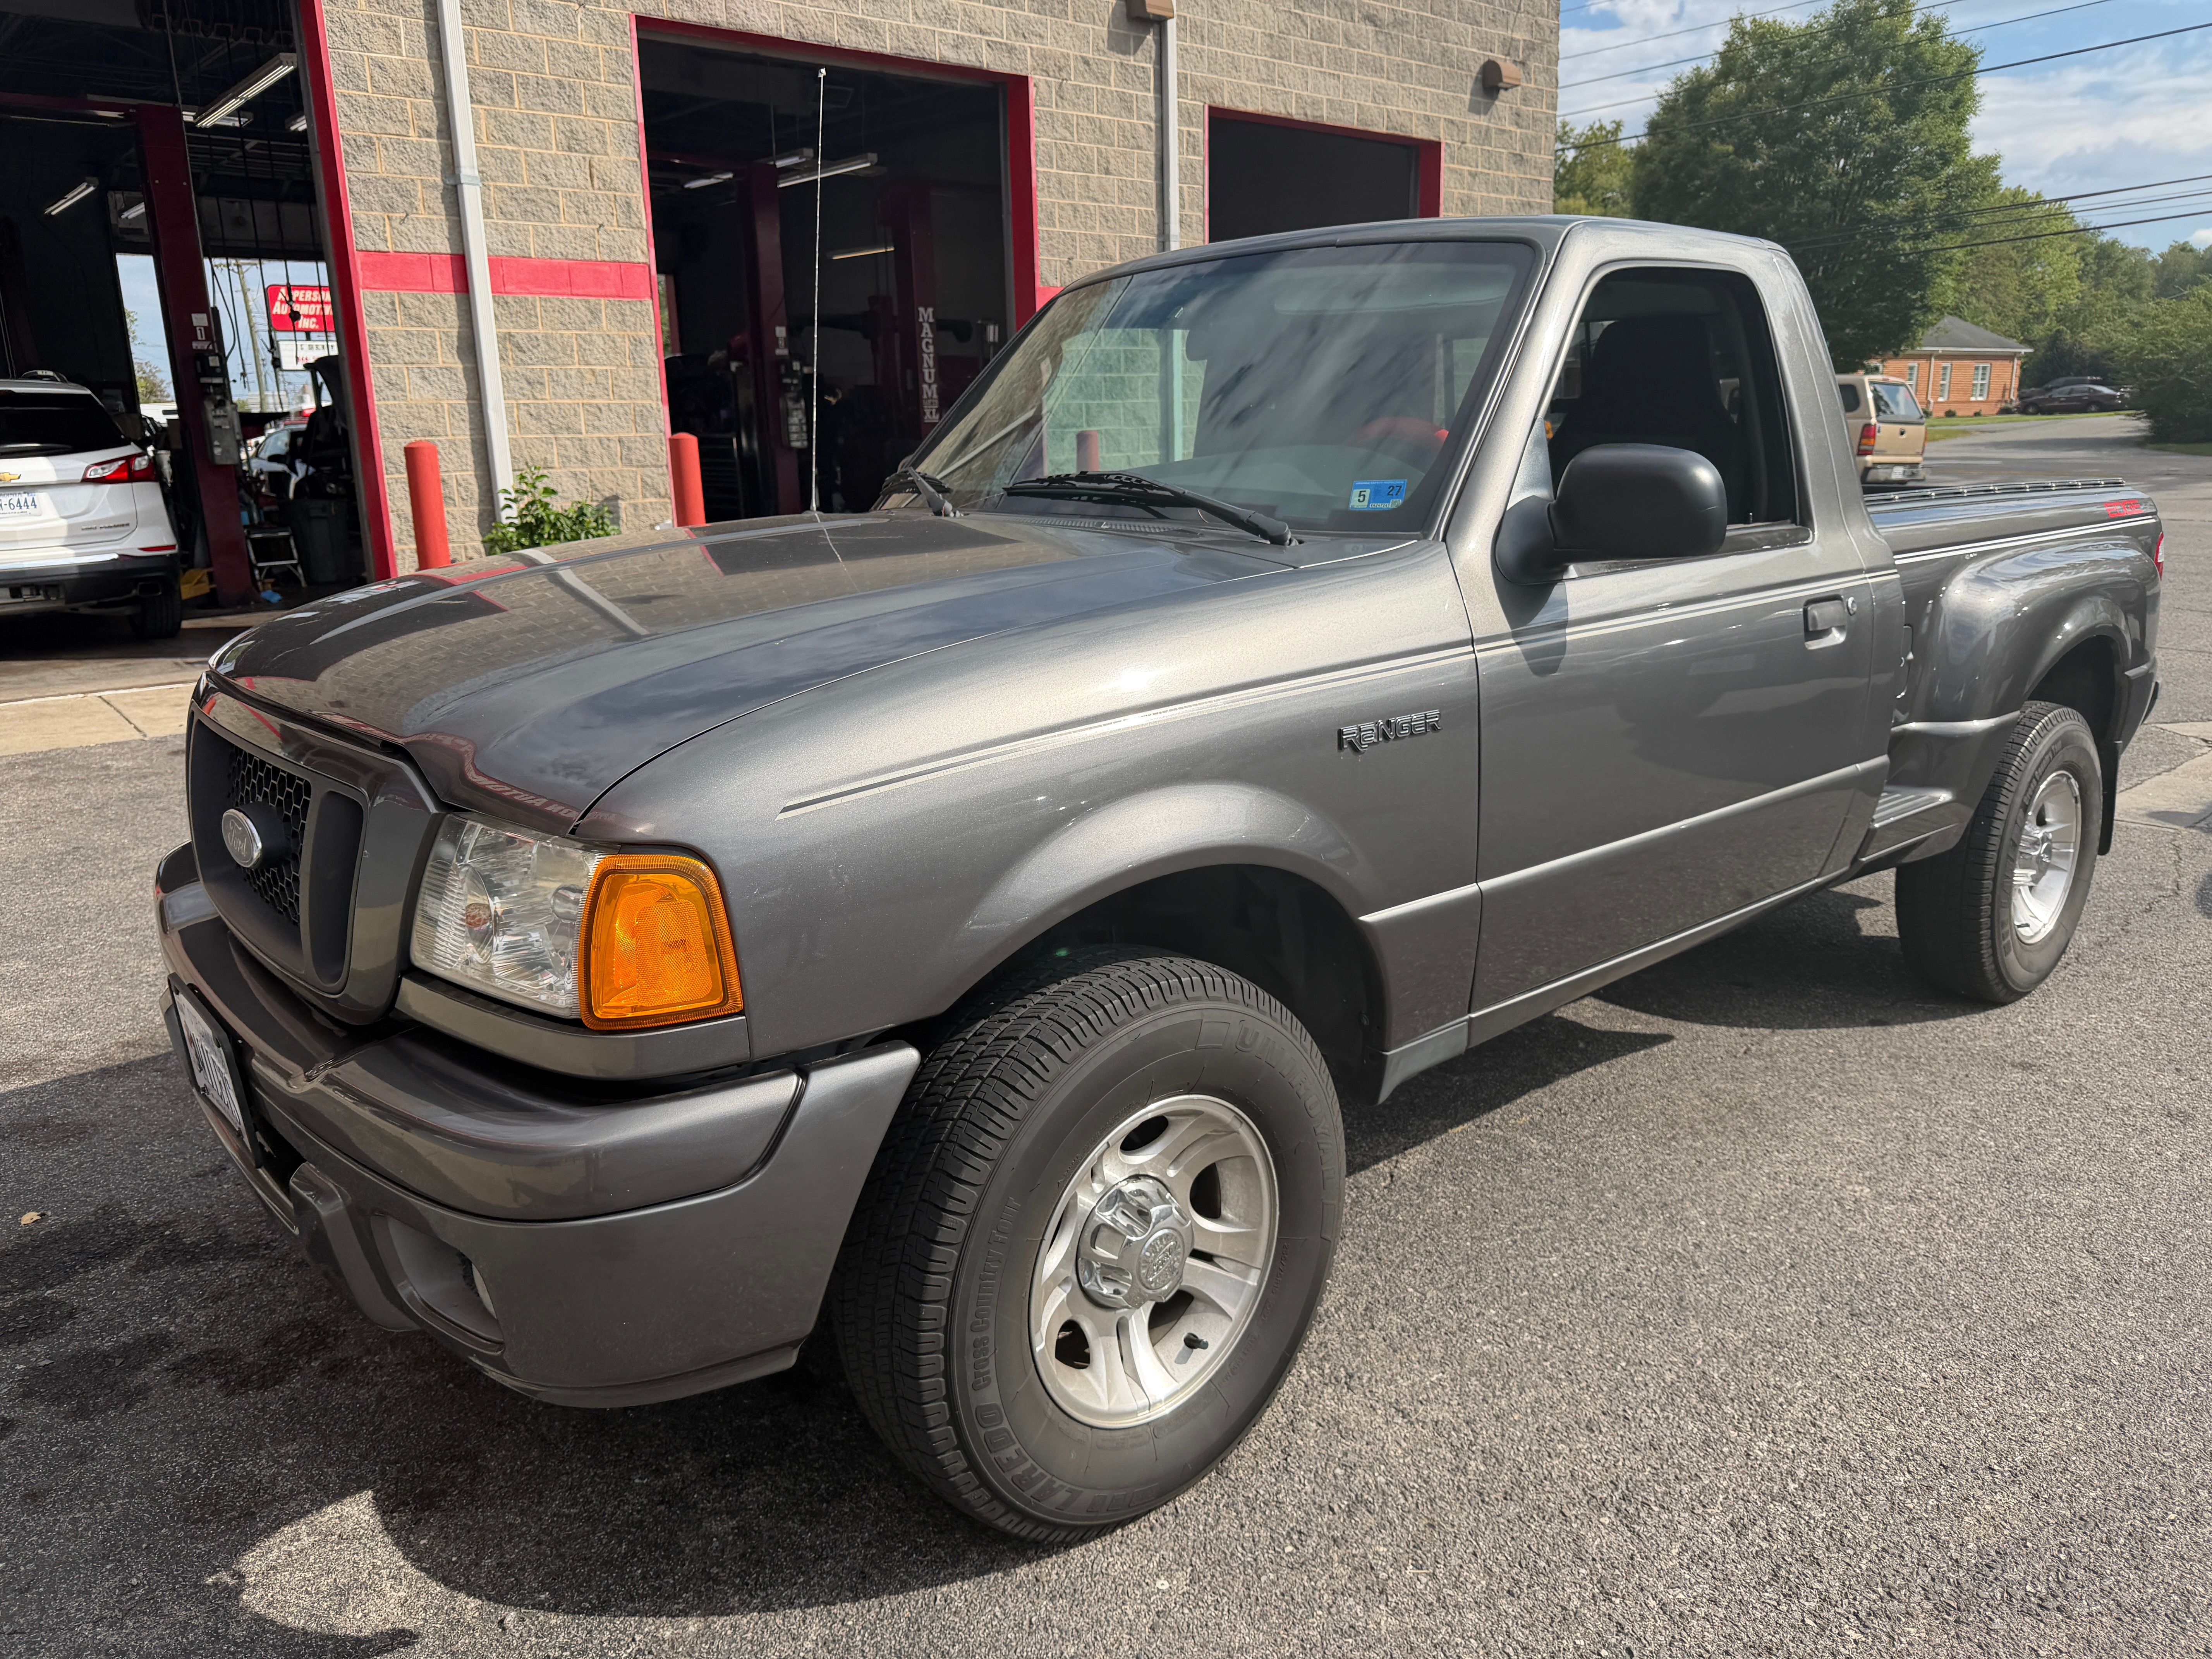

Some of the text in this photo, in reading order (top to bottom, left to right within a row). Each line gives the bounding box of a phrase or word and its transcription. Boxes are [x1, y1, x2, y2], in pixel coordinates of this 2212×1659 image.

[918, 306, 939, 399] MAGNUM
[924, 409, 940, 420] XL
[1357, 490, 1367, 503] 5
[1387, 485, 1403, 496] 27
[1338, 709, 1442, 753] RANGER
[228, 819, 247, 857] Ford
[1235, 1020, 1336, 1190] UNIROYAL
[970, 1196, 1021, 1391] Cross Country Tour
[976, 1403, 1084, 1511] LAREDO
